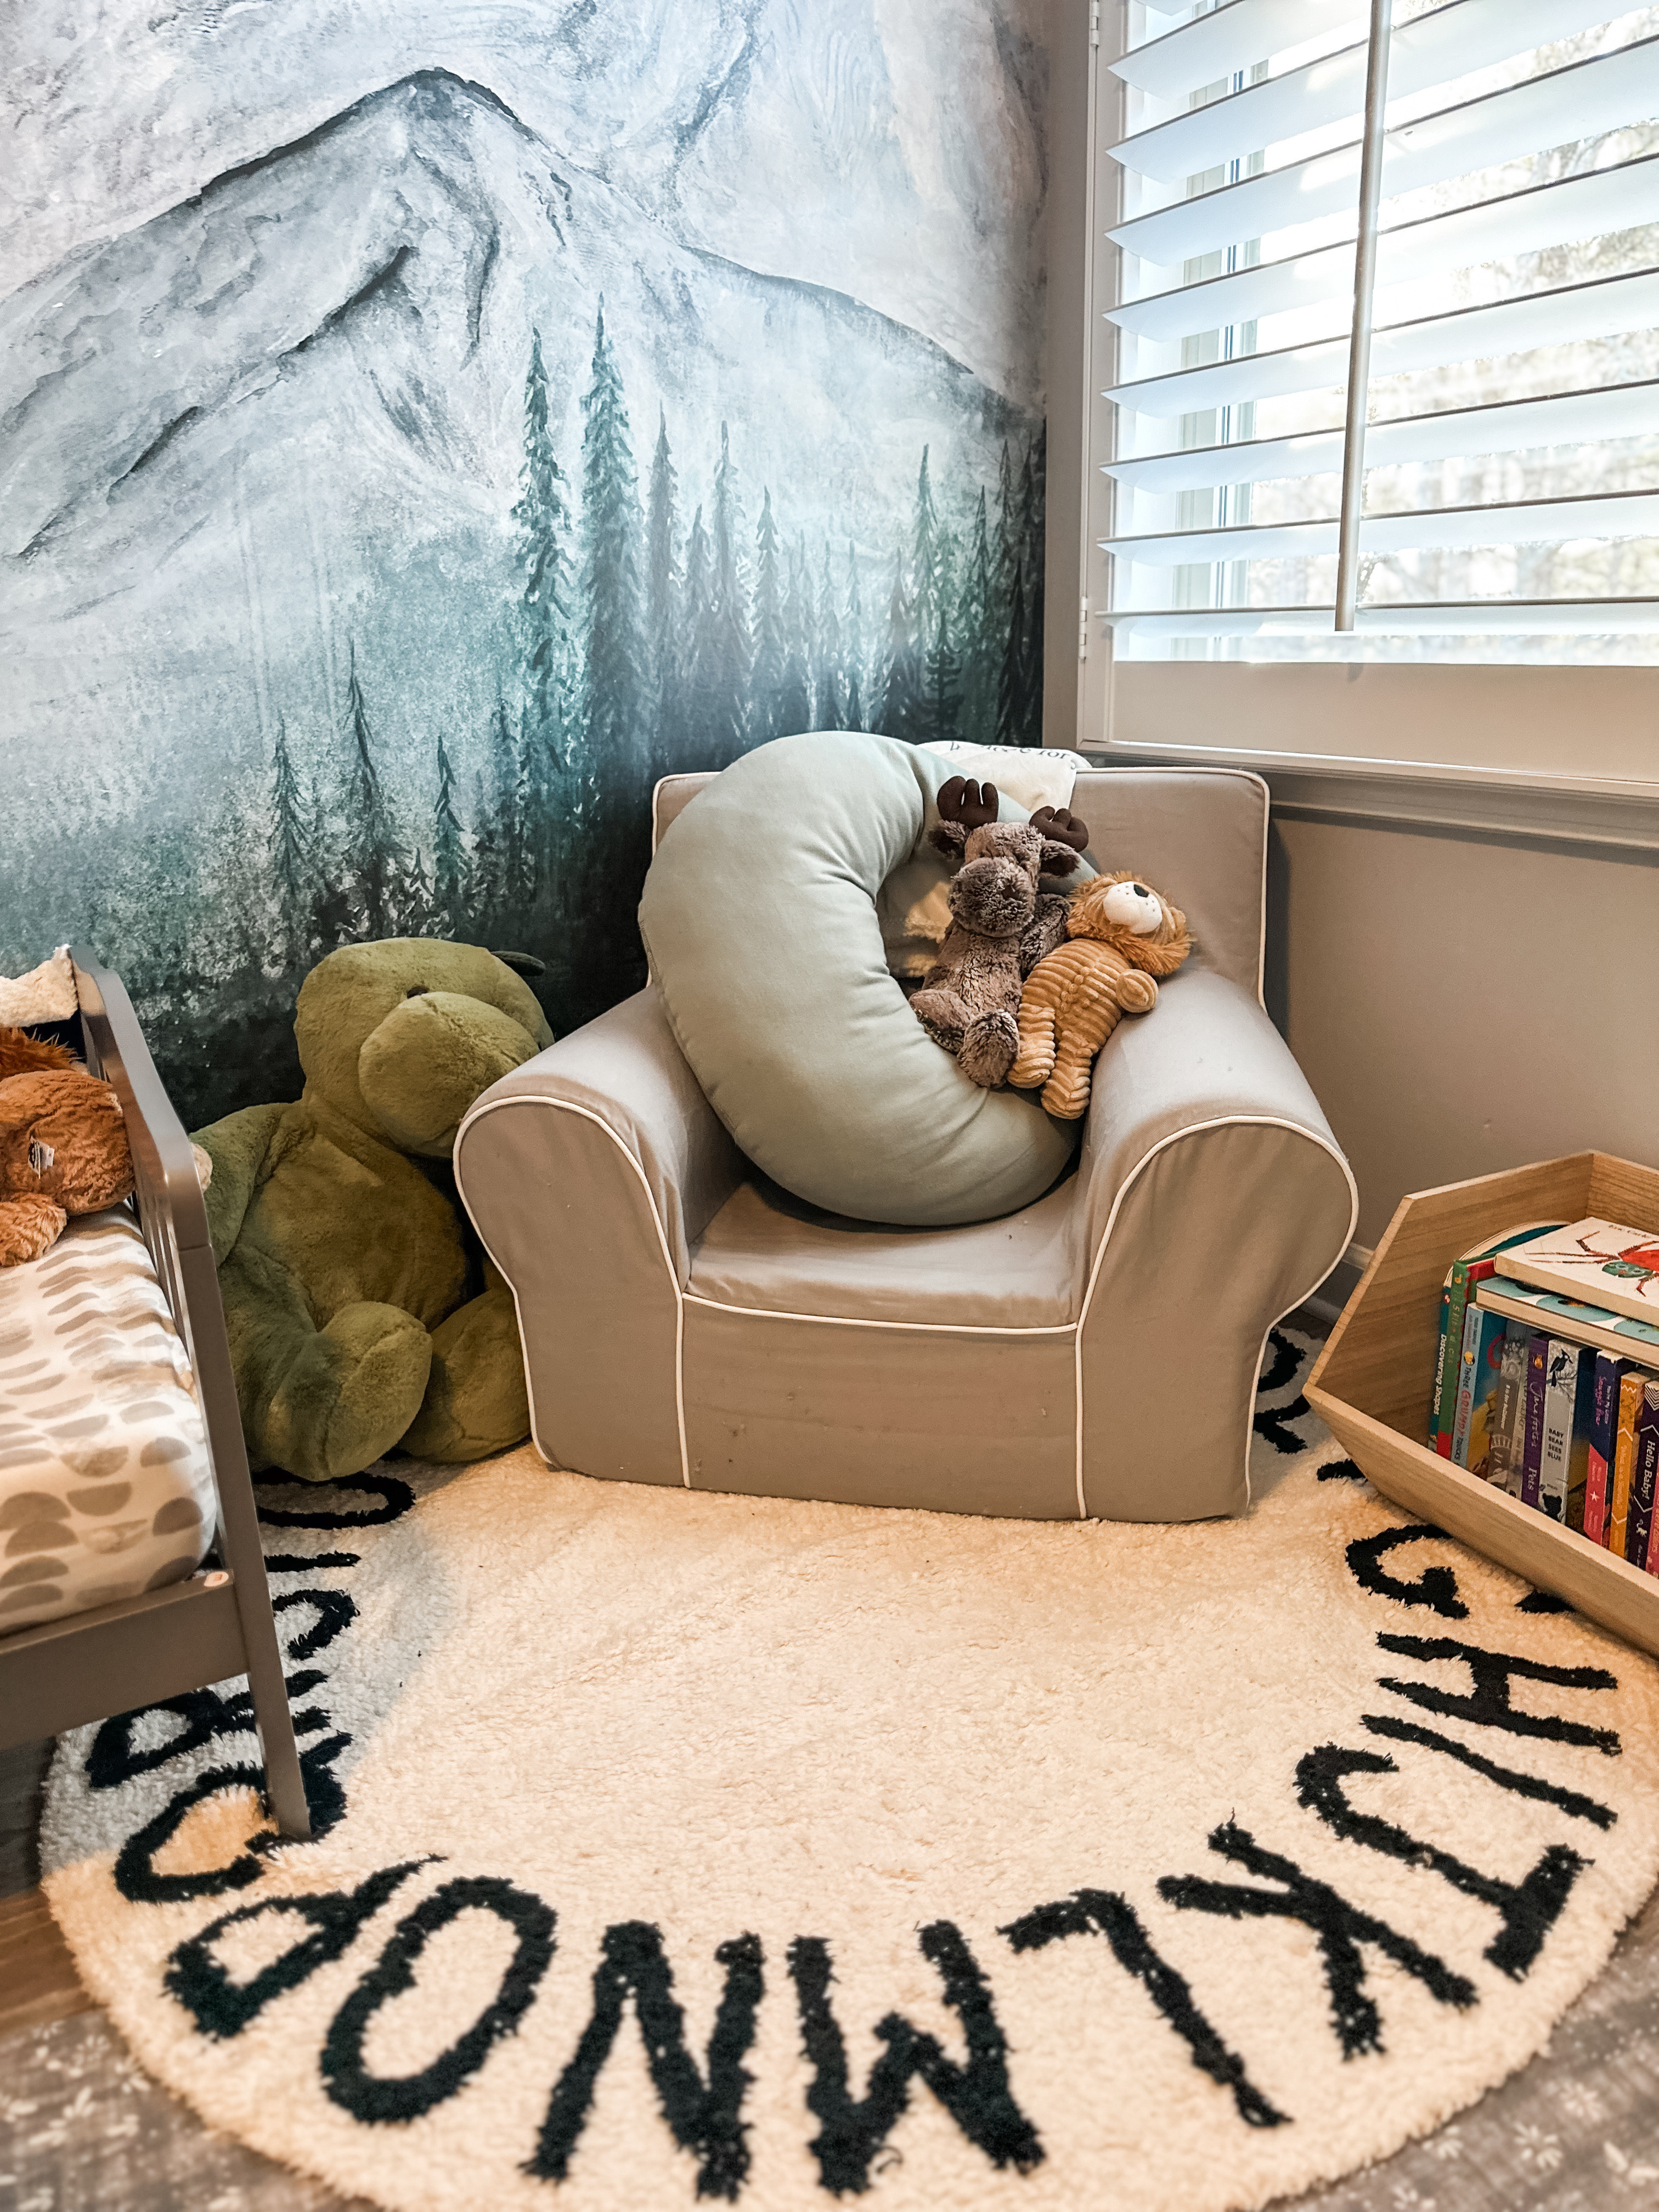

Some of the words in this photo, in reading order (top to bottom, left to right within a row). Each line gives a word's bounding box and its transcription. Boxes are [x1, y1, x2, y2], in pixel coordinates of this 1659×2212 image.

[1435, 1334, 1447, 1385] Discovering
[1463, 1367, 1471, 1389] THREE
[1433, 1385, 1442, 1415] Shapes
[1548, 1435, 1563, 1446] BEAR
[1549, 1427, 1564, 1438] BABY
[1547, 1451, 1561, 1462] BLUE
[1548, 1443, 1561, 1454] SEES
[1645, 1440, 1656, 1468] Hello
[1527, 1466, 1537, 1491] Pets
[1641, 1469, 1652, 1500] Baby!
